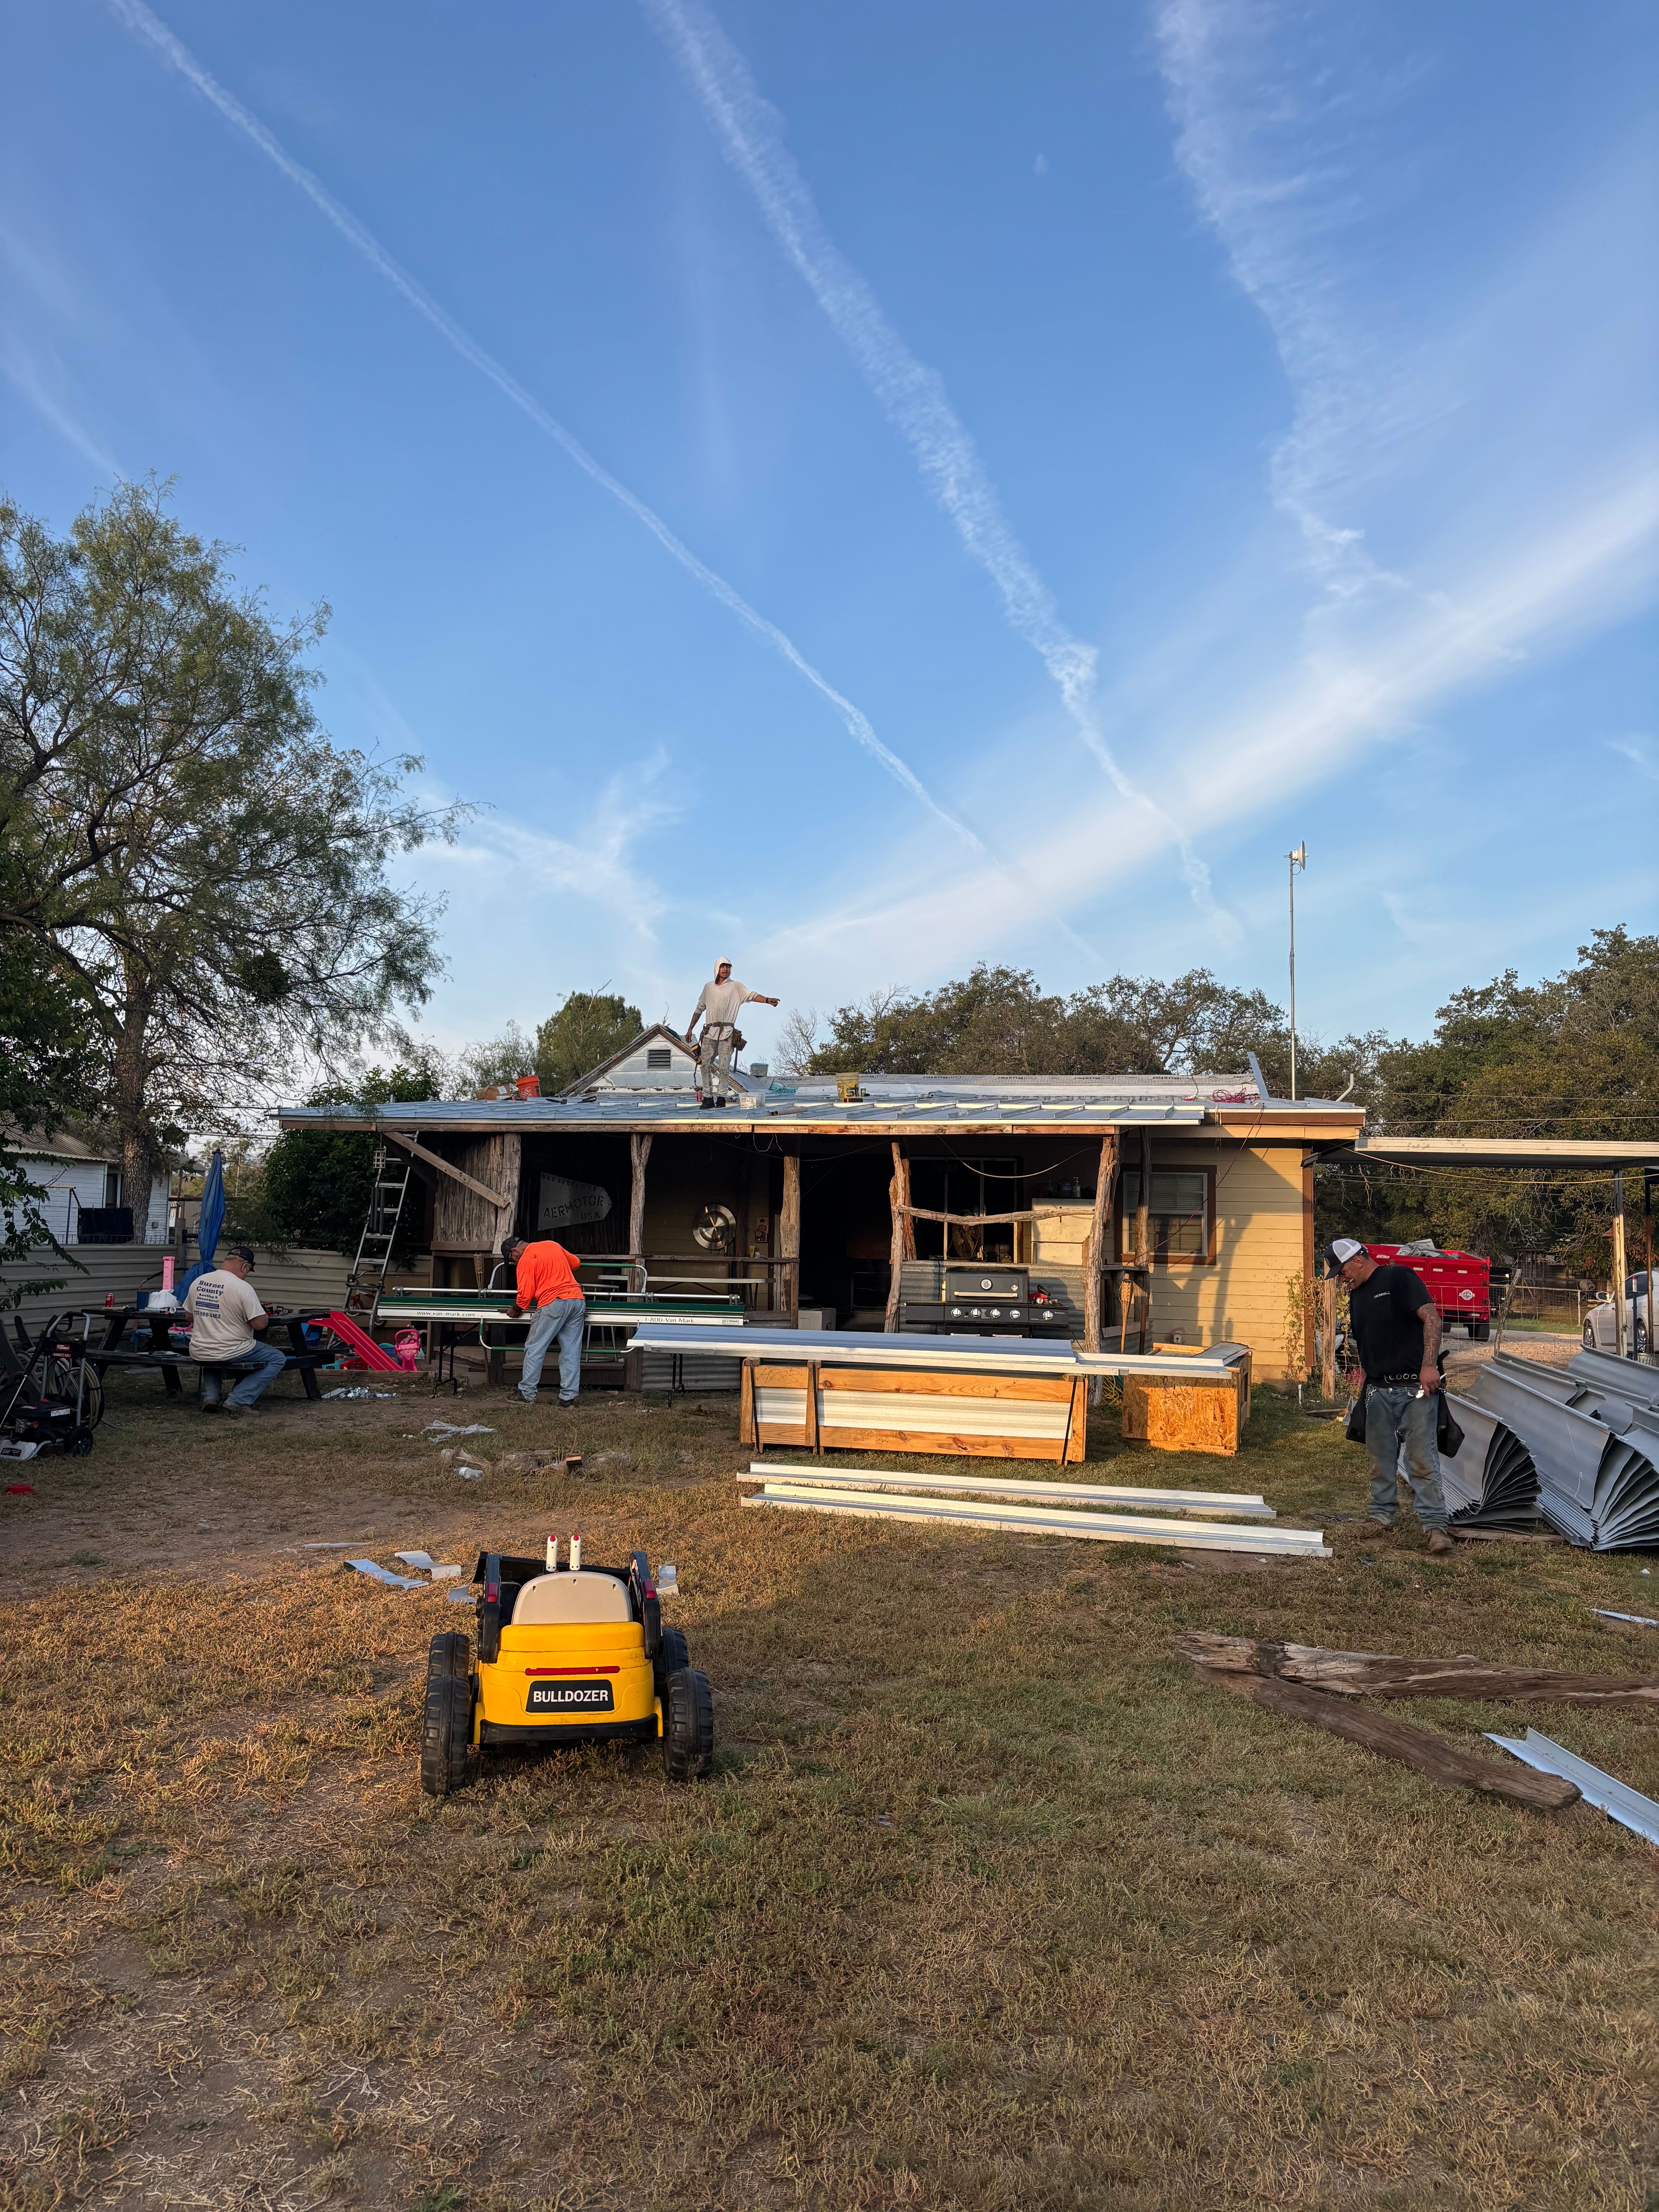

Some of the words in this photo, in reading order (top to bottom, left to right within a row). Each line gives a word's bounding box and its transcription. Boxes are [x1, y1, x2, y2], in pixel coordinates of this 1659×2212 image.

[558, 1178, 585, 1189] ANGELO
[543, 1195, 604, 1218] AERMOTOR
[581, 1212, 600, 1220] USA
[199, 1280, 224, 1289] Burnet
[197, 1286, 223, 1296] County
[533, 1690, 608, 1702] BULLDOZER
